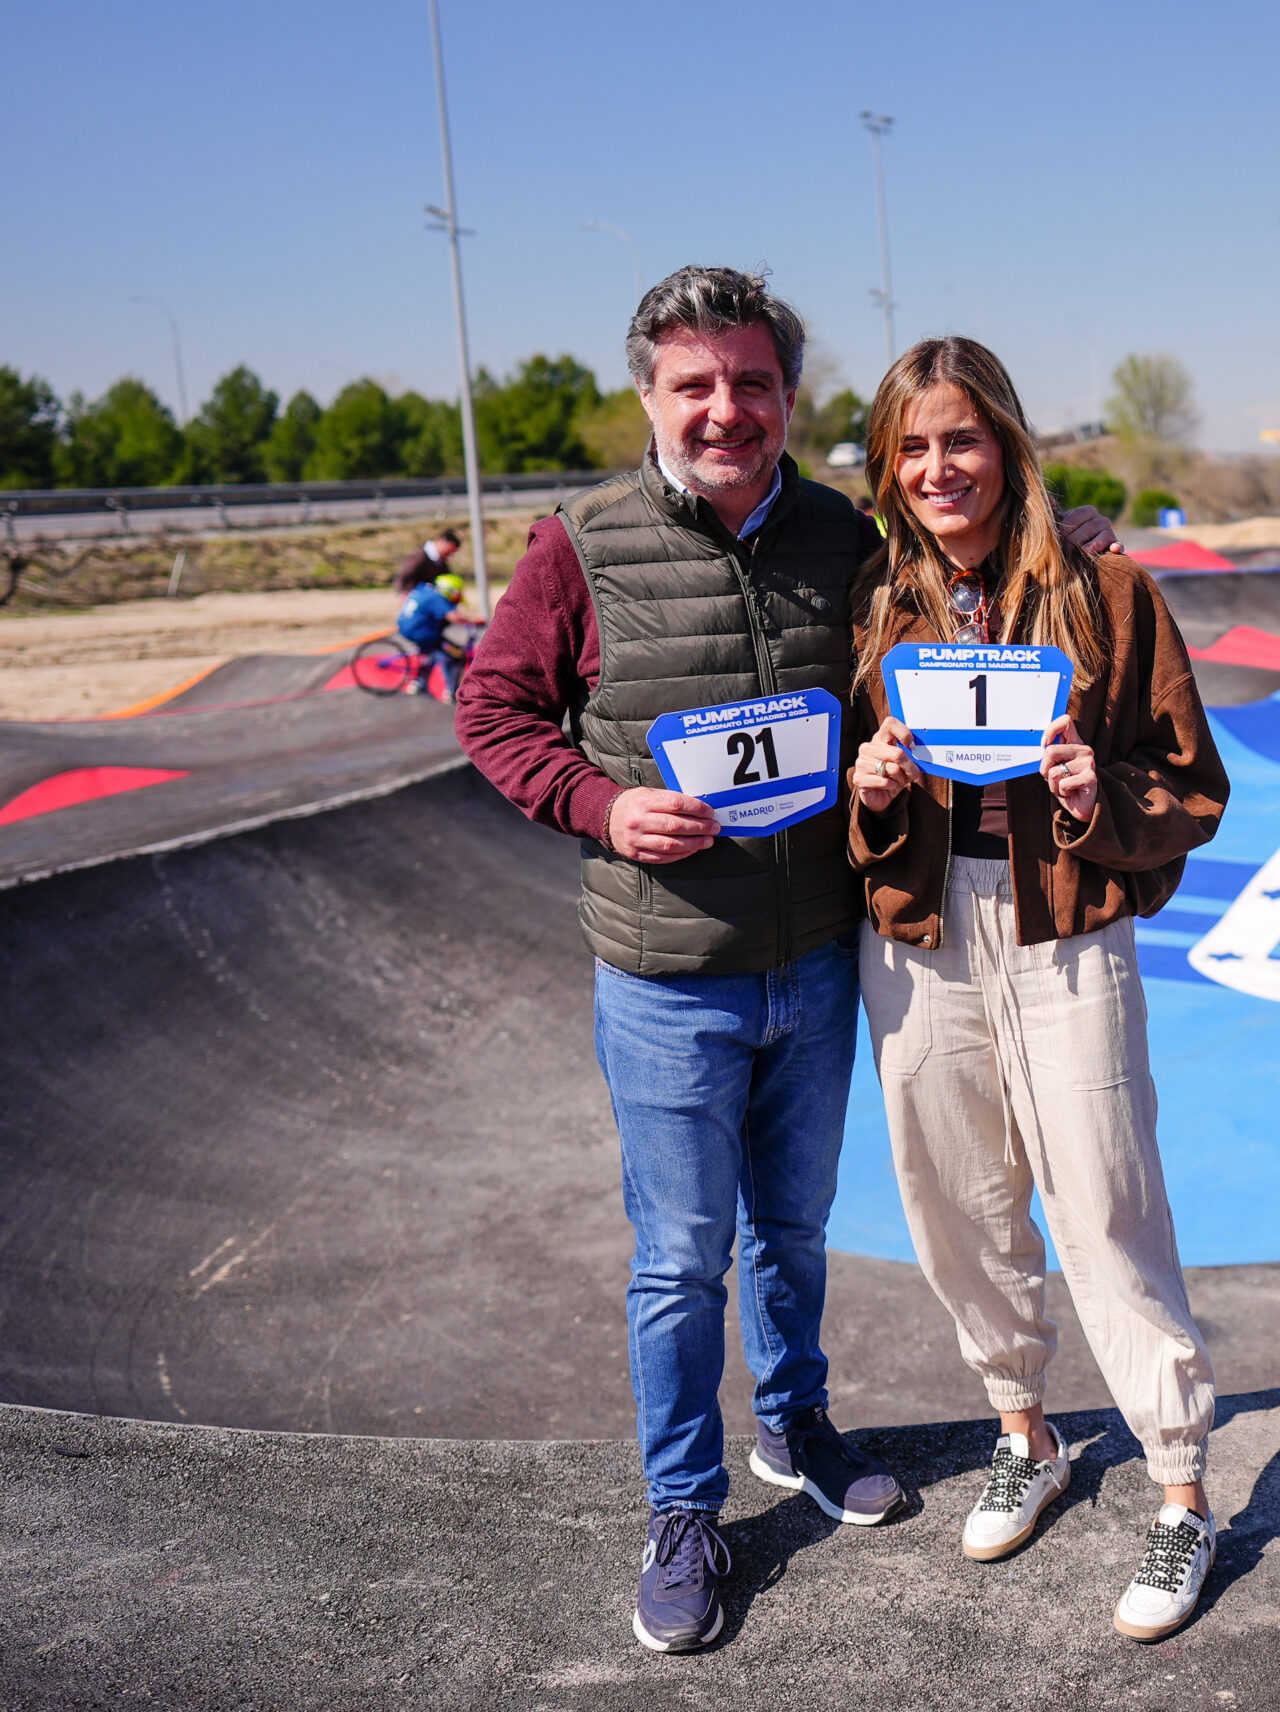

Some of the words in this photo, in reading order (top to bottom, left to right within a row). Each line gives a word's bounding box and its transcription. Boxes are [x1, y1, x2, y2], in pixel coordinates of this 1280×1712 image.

[919, 648, 1041, 662] PUMPTRACK
[683, 695, 808, 728] PUMPTRACK
[969, 674, 987, 726] 1
[686, 720, 742, 735] CAMPEONATO
[756, 712, 787, 723] MADRID
[726, 727, 780, 786] 21
[956, 753, 992, 763] MADRID
[739, 805, 775, 818] MADRID
